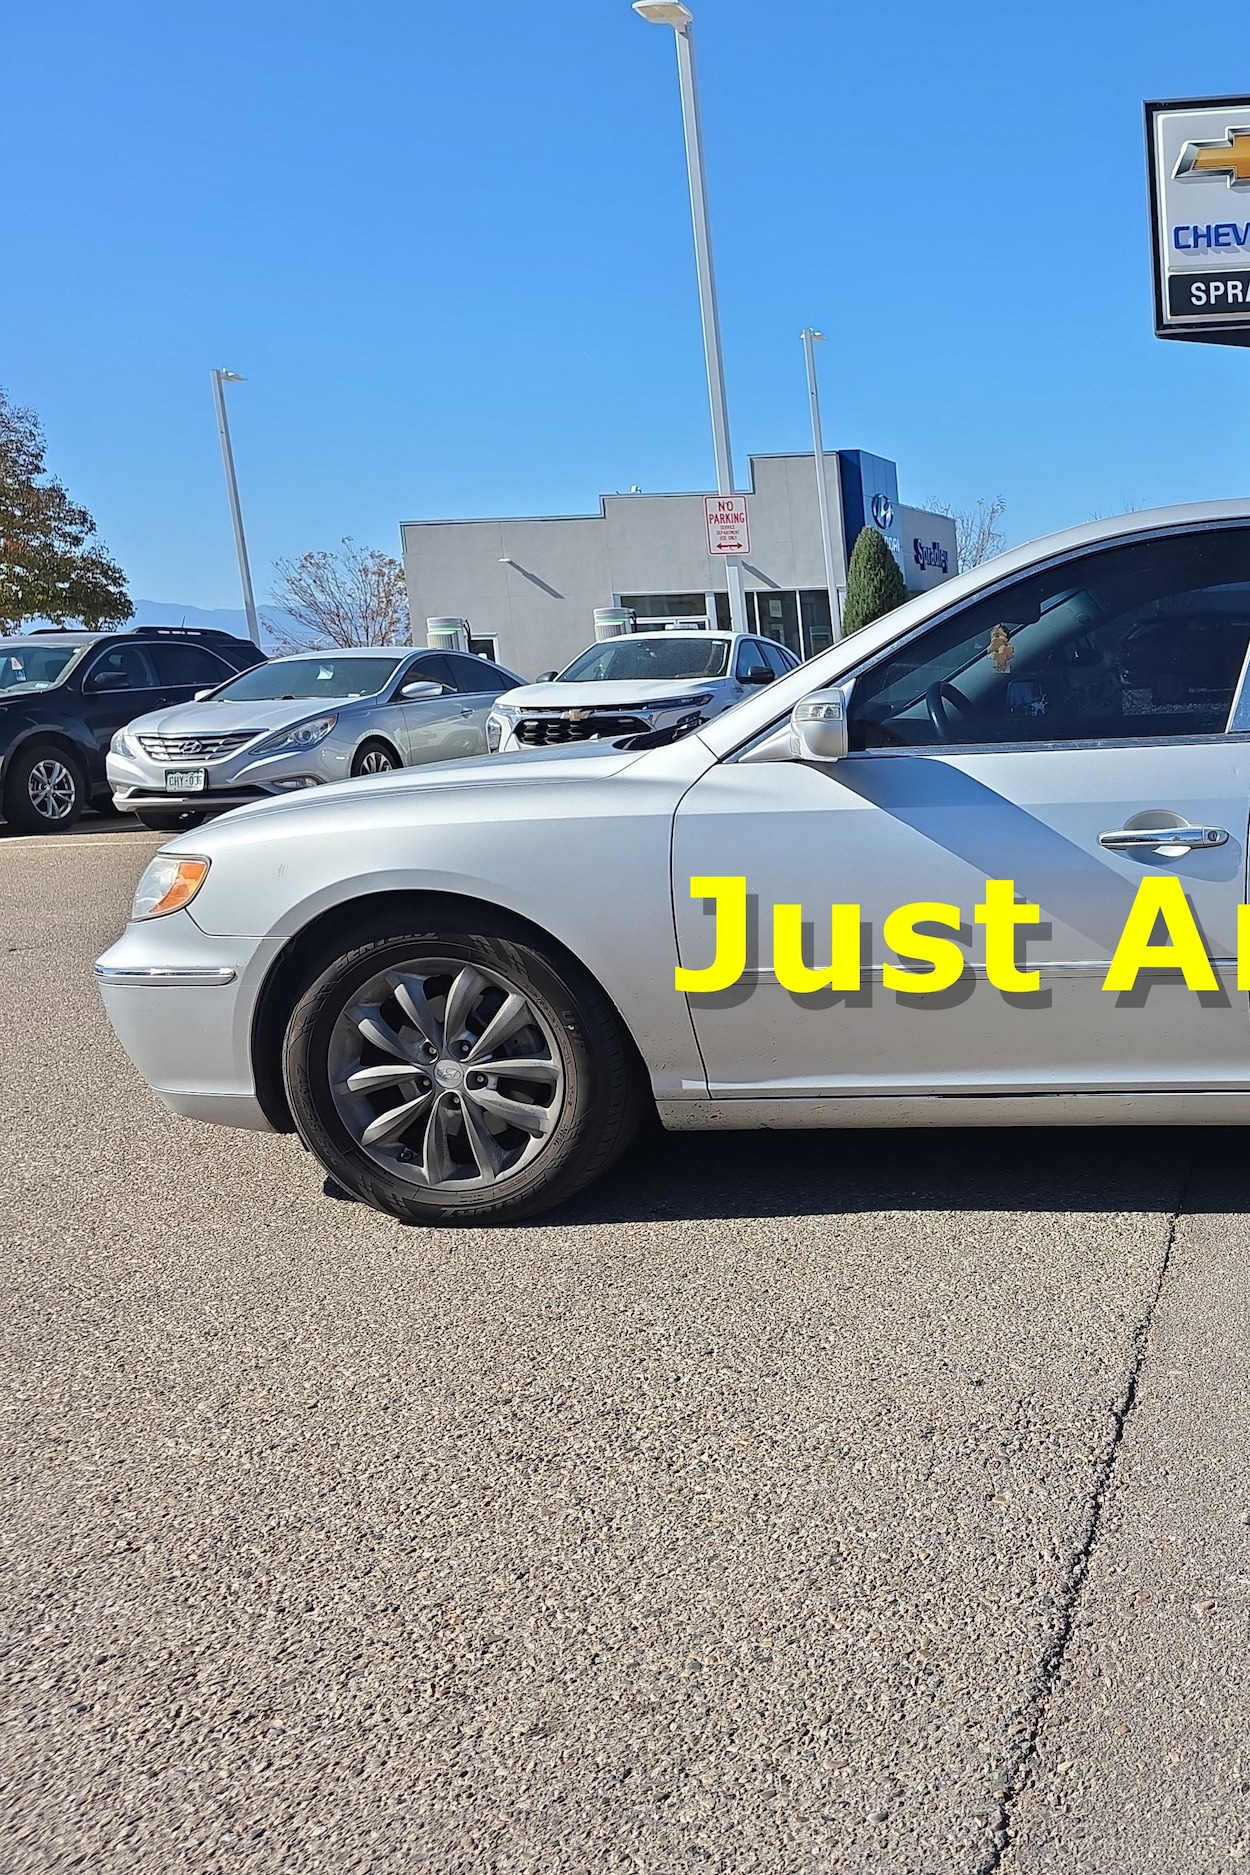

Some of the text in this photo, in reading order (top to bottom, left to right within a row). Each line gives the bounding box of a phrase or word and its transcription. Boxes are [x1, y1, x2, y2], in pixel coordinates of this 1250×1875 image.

[718, 500, 734, 512] NO
[709, 512, 745, 525] PARKING
[913, 538, 948, 573] Spradley
